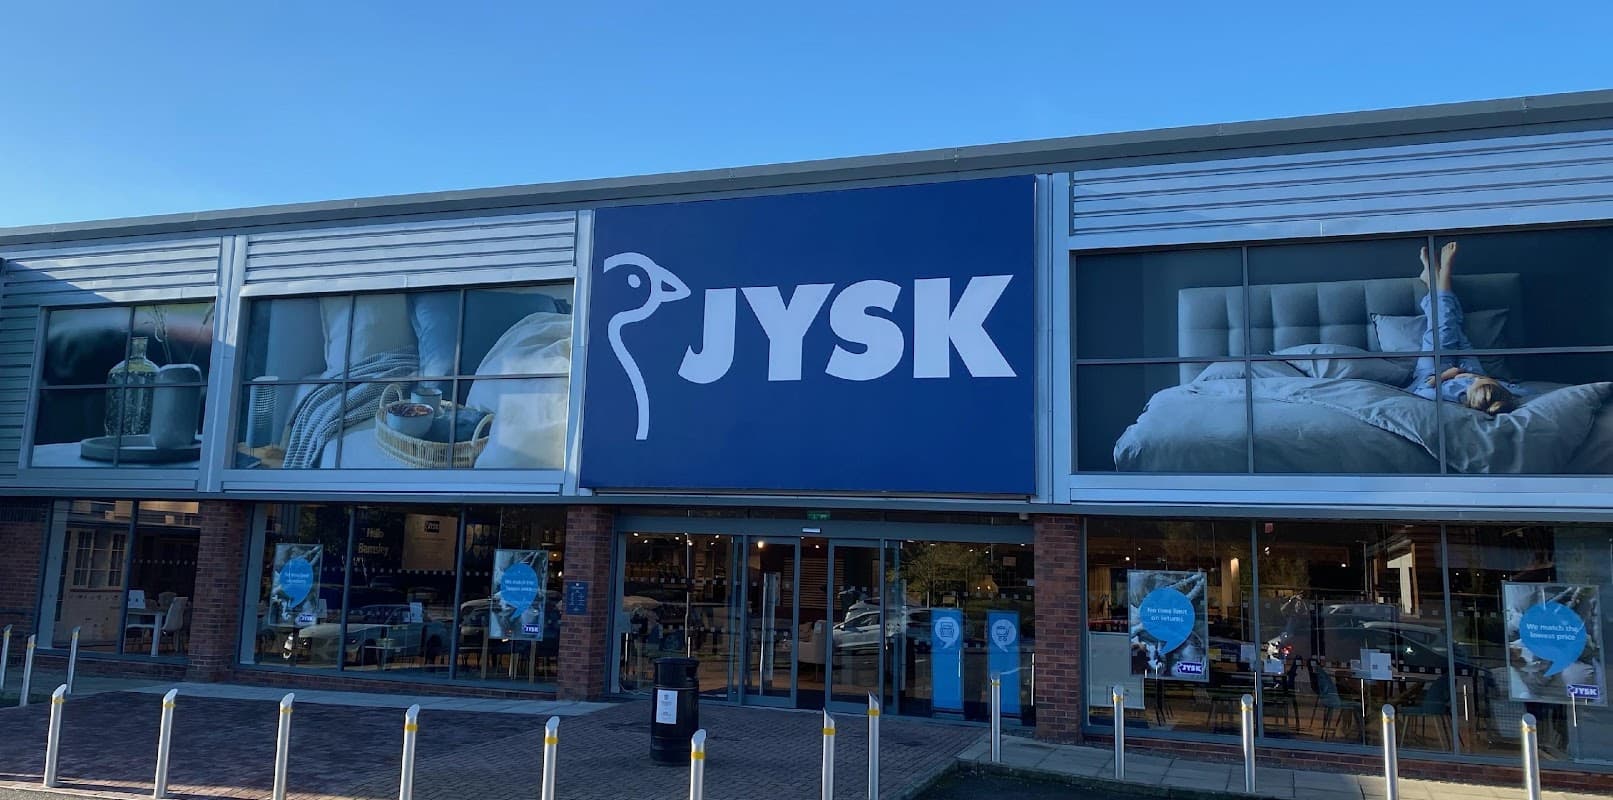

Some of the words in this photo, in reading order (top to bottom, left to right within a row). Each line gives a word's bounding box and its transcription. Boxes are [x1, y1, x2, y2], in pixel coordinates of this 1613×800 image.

[677, 274, 1017, 384] JYSK
[1540, 624, 1565, 632] match
[1565, 624, 1578, 633] the
[1530, 631, 1556, 640] lowest
[1556, 633, 1576, 641] price
[1181, 665, 1202, 673] JYSK
[1573, 687, 1598, 696] JYSK
